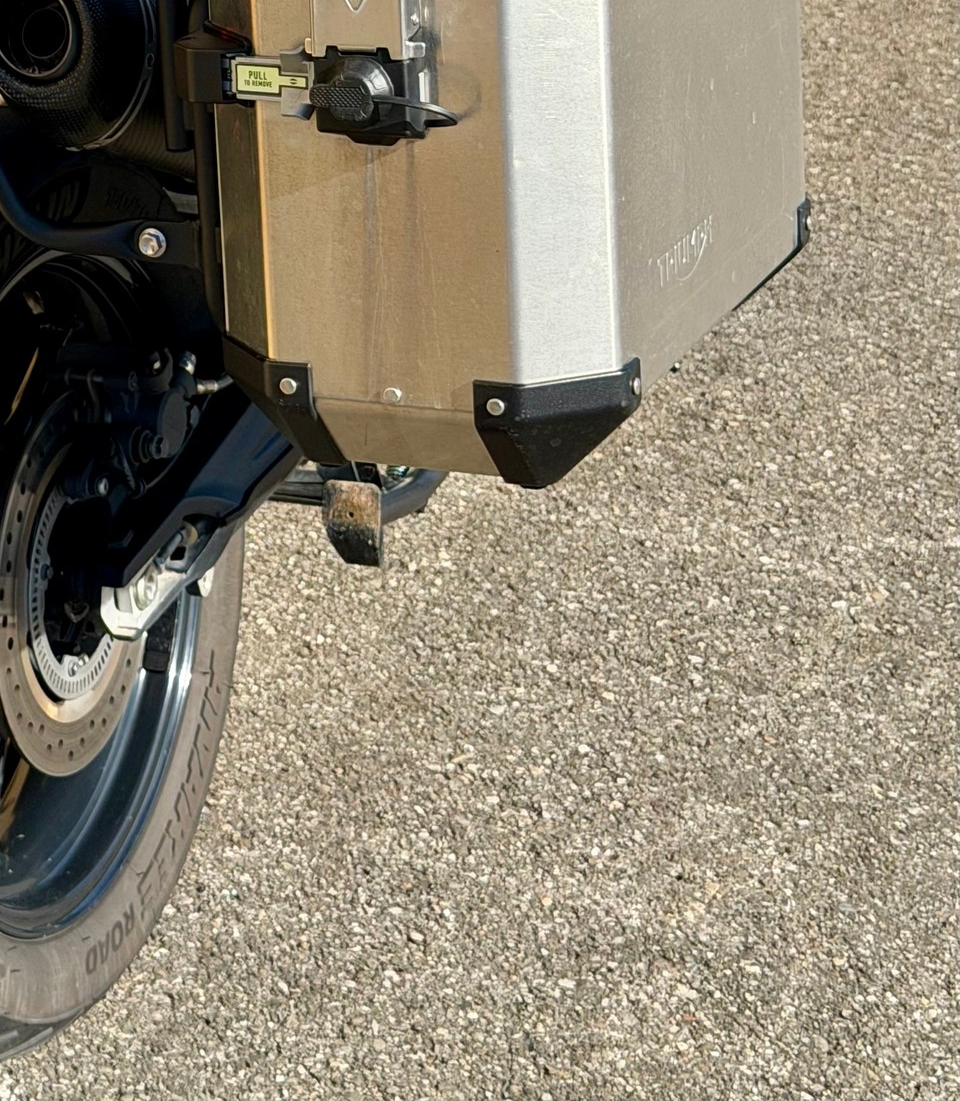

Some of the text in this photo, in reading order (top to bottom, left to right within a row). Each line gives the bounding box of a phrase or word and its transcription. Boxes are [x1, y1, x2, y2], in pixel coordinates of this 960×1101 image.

[248, 70, 267, 80] PULL
[251, 80, 272, 88] REMOVE
[85, 901, 136, 975] ROAD
